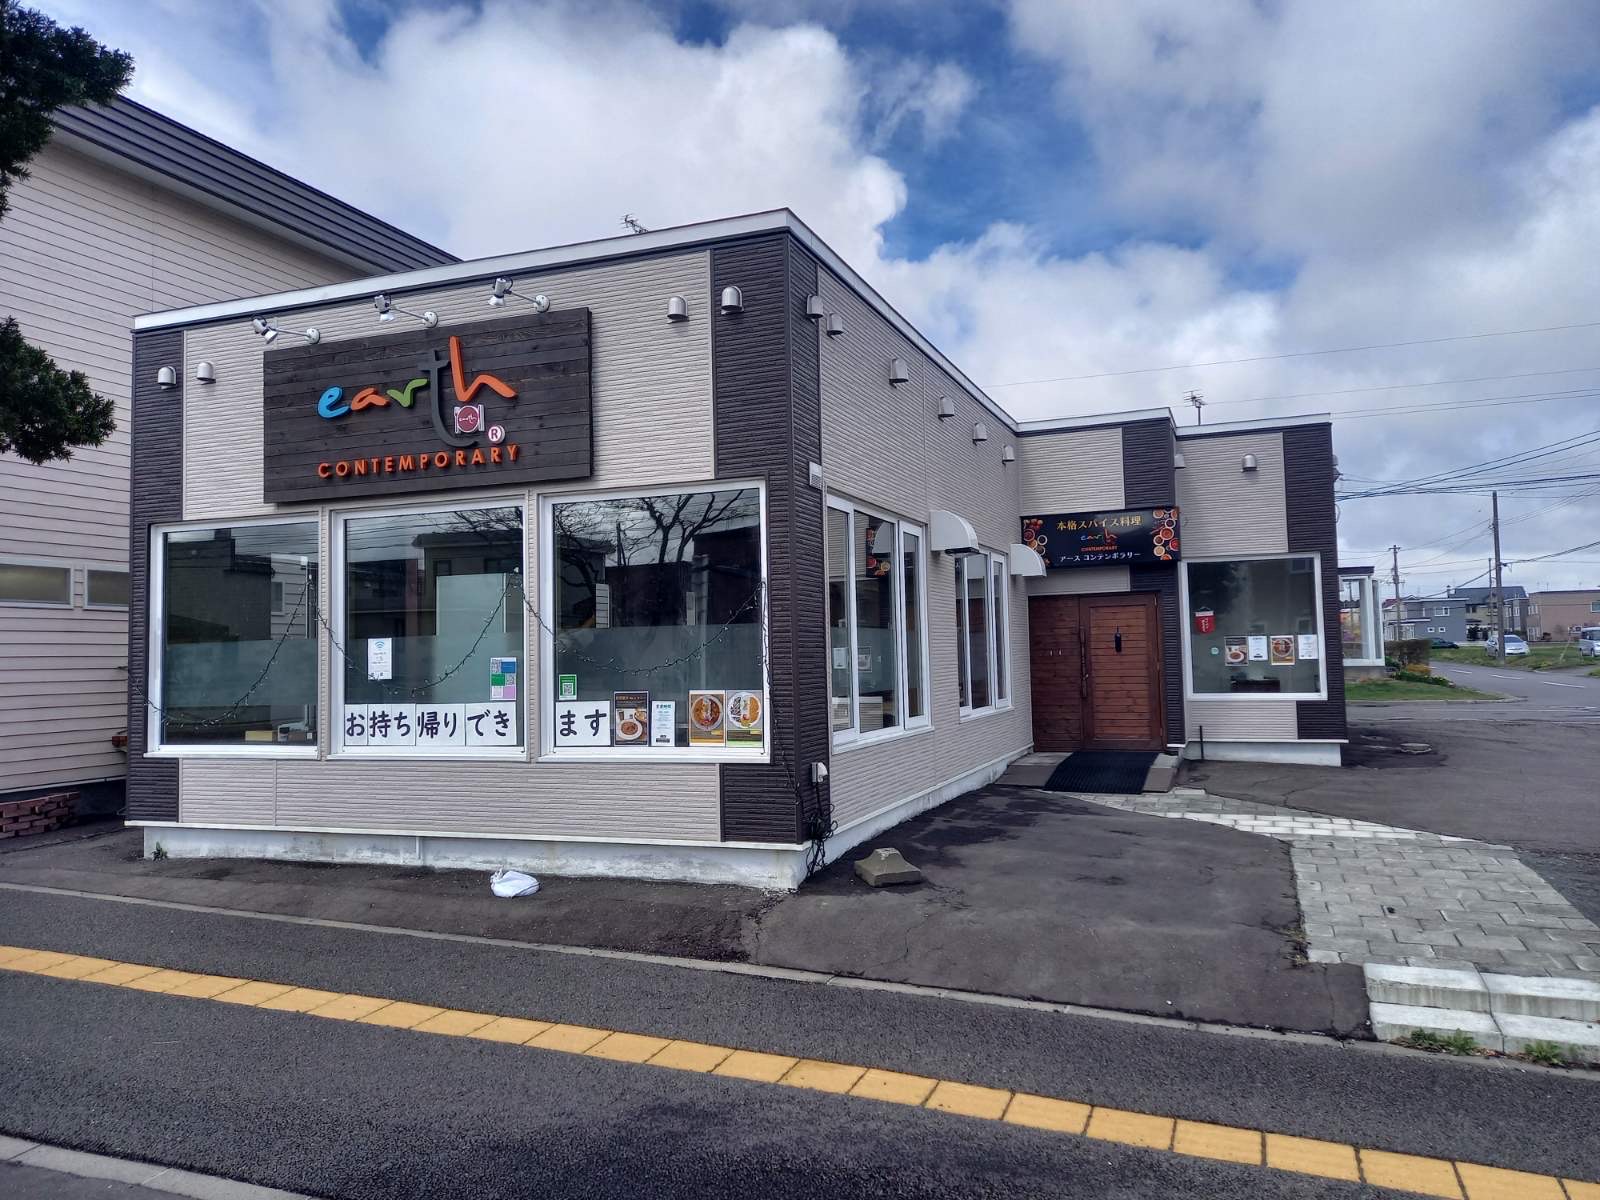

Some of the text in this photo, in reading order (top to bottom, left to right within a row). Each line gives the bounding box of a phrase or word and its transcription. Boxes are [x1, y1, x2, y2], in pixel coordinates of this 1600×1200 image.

[316, 335, 519, 448] earth
[318, 444, 519, 478] CONTEMPORARY
[1057, 515, 1142, 530] 本格スパイス料理
[1083, 551, 1141, 561] コンテンポラリー
[346, 709, 608, 738] お持ち帰りでき ます
